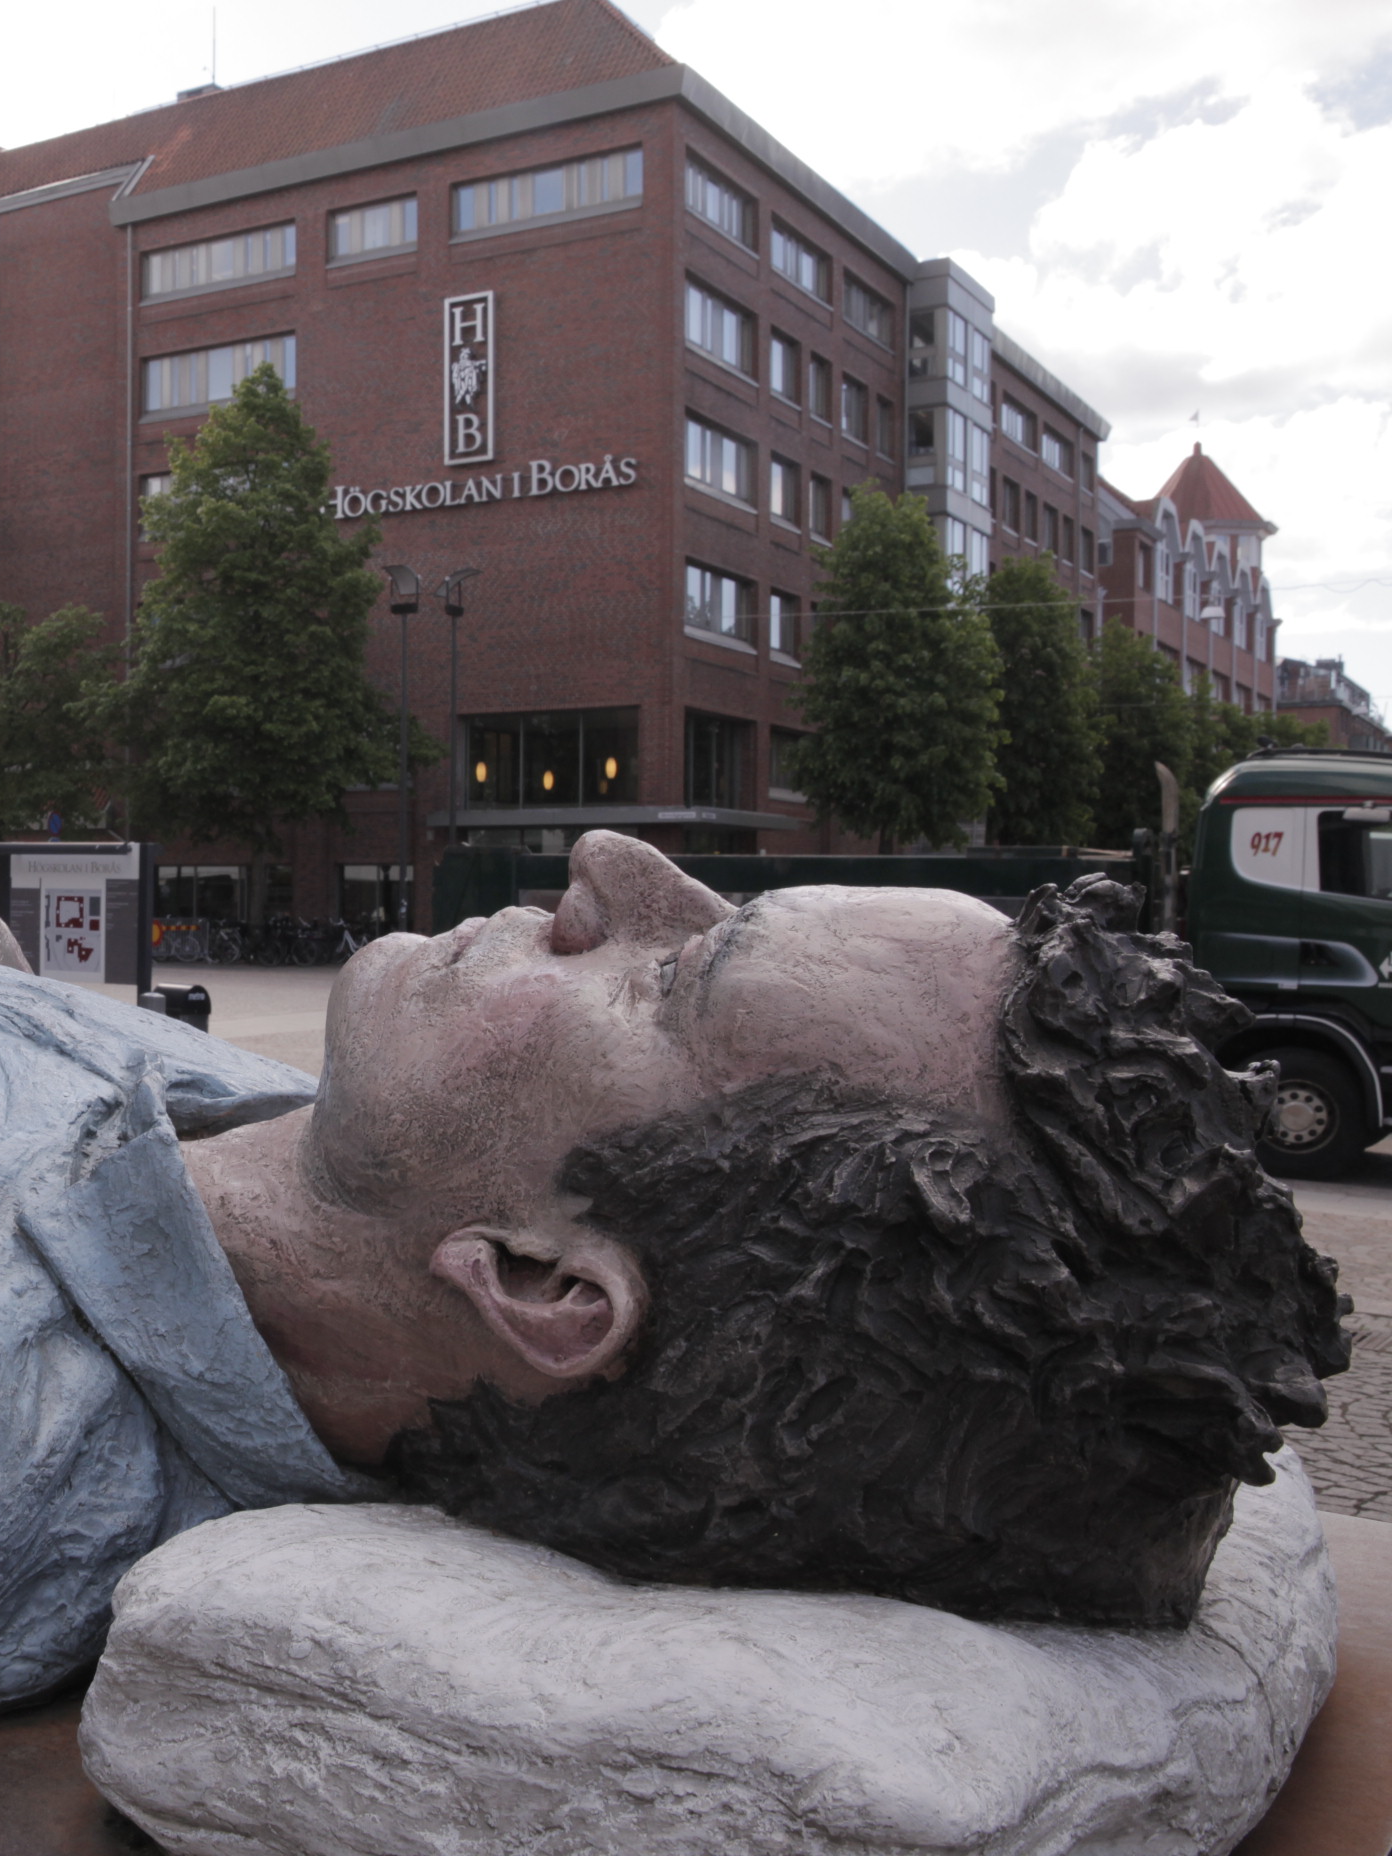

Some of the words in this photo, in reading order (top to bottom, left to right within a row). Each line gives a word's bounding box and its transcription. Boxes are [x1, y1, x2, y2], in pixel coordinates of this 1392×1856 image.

[451, 302, 486, 346] H
[455, 412, 483, 453] B
[528, 454, 637, 496] BORÅS
[1250, 831, 1284, 857] 917
